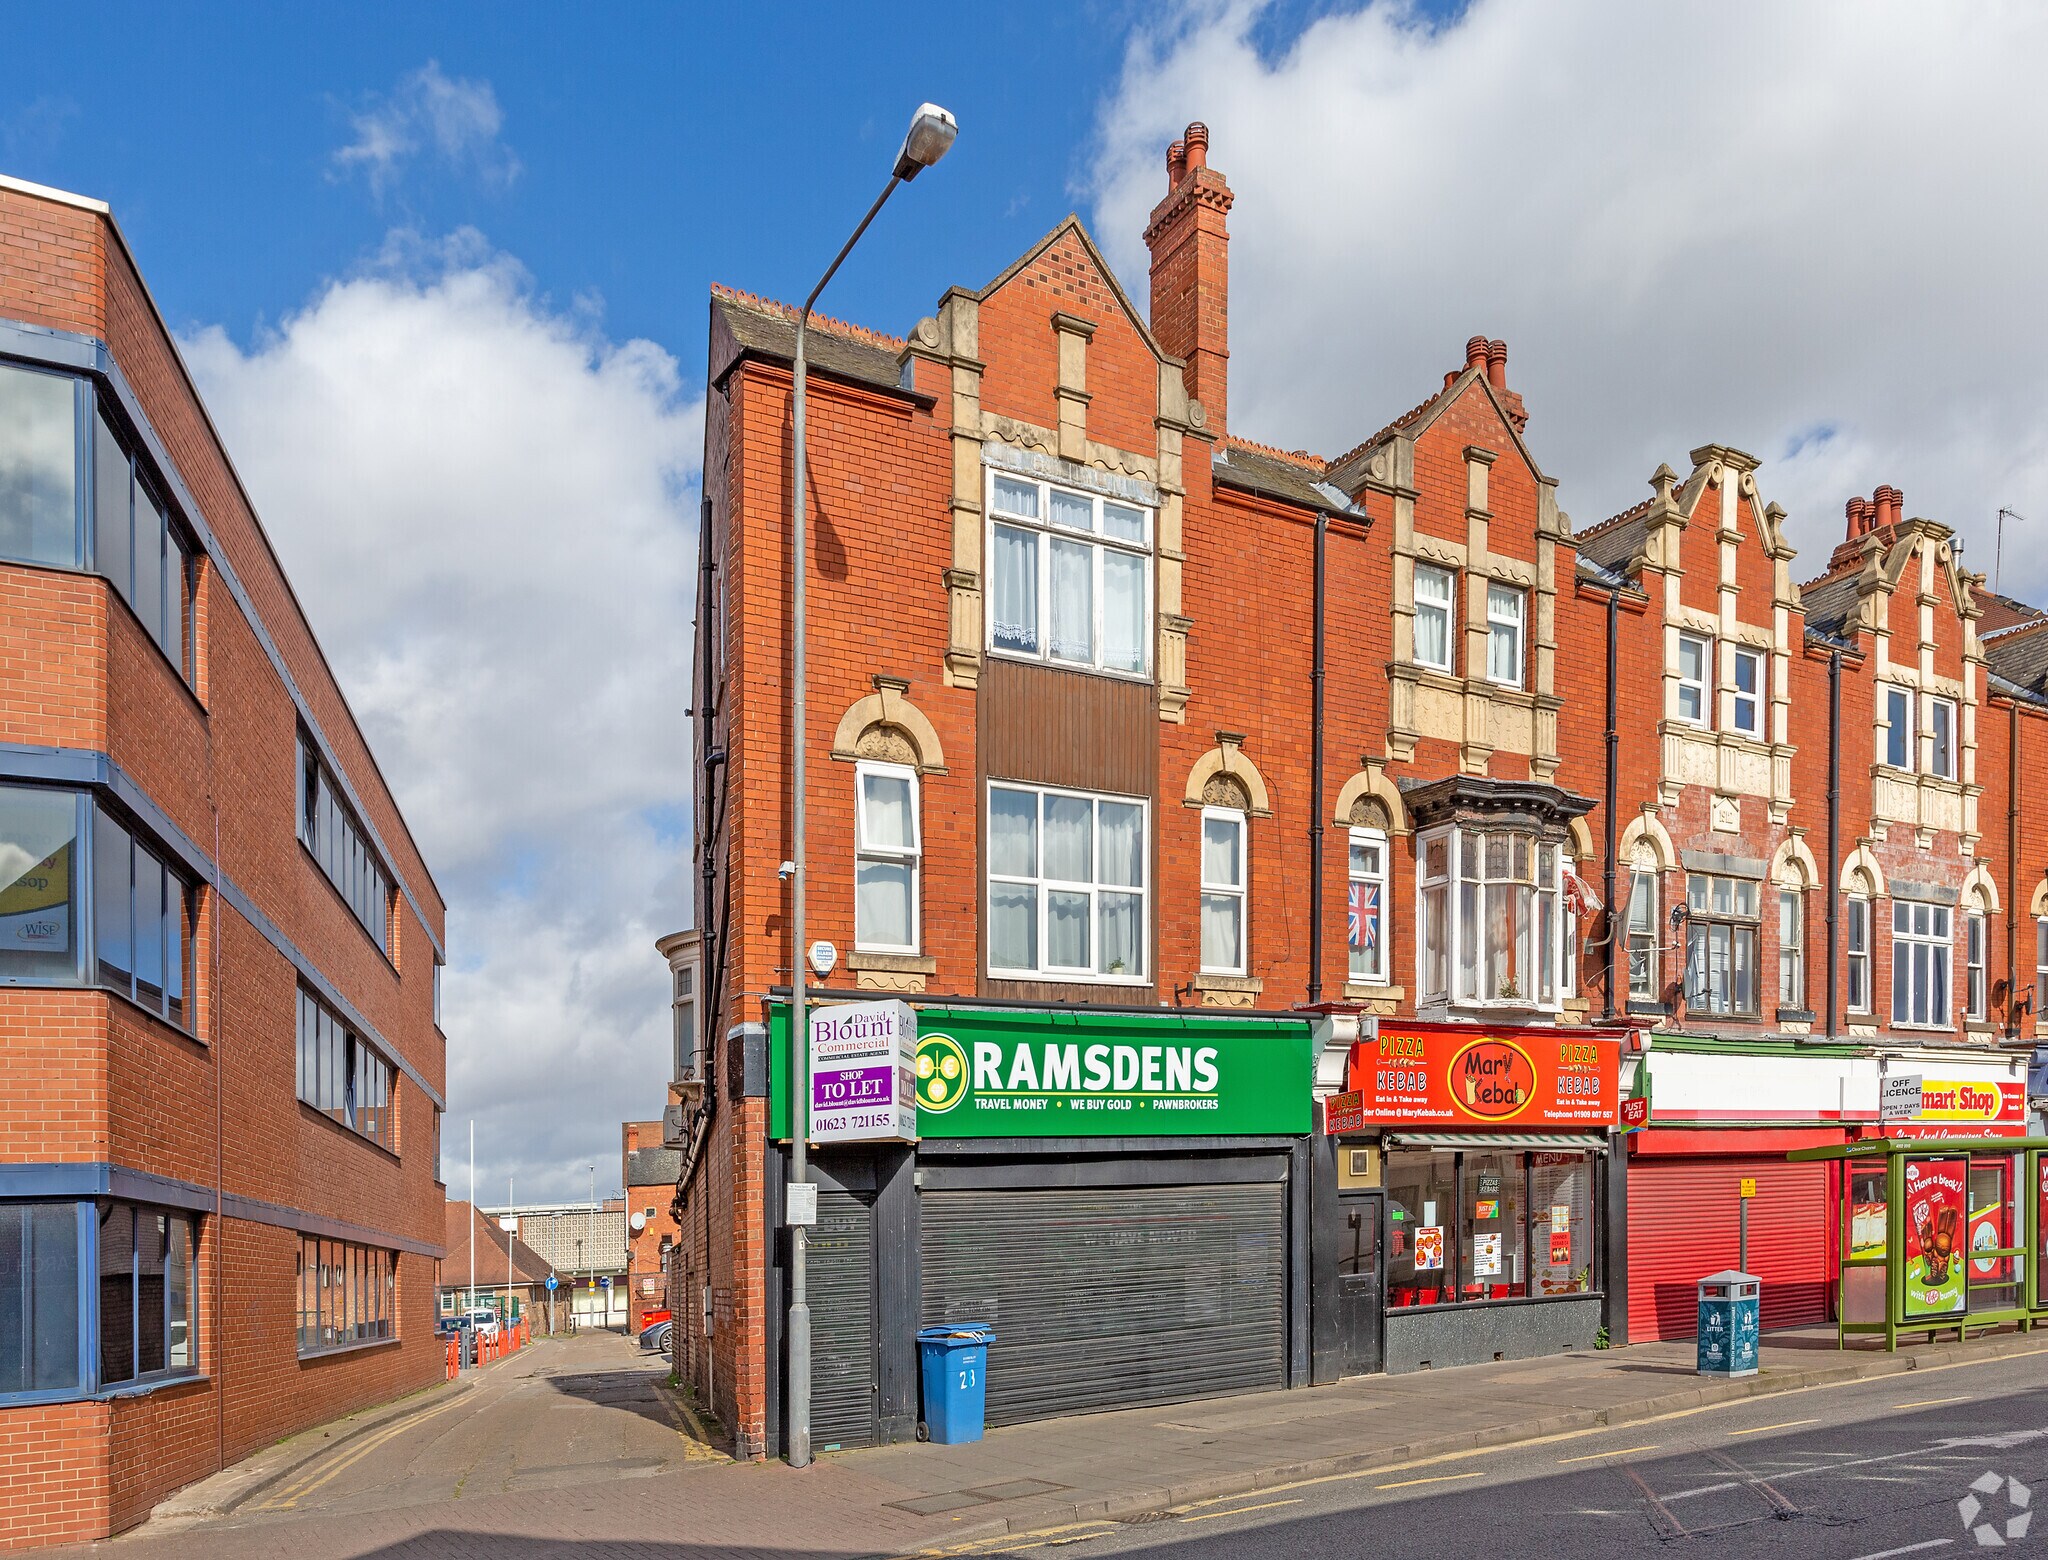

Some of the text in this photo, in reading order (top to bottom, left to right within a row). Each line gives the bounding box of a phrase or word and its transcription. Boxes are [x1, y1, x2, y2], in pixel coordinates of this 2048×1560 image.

[854, 1011, 886, 1024] David
[814, 1016, 893, 1042] Blount
[818, 1037, 889, 1054] Commercial
[1380, 1036, 1424, 1057] PIZZA
[1560, 1044, 1598, 1063] PIZZA
[974, 1041, 1219, 1092] RAMSDENS
[840, 1070, 864, 1080] SHOP
[1377, 1071, 1427, 1092] KEBAB
[822, 1079, 883, 1099] TO LET
[1558, 1076, 1600, 1095] KEBAB
[1892, 1079, 1910, 1088] OFF
[974, 1099, 1048, 1110] TRAVEL MONEY
[1070, 1100, 1132, 1110] WE BUY GOLD
[1153, 1100, 1218, 1110] PAWNBROKERS
[1330, 1094, 1359, 1110] PIZZA
[1624, 1101, 1644, 1112] JUST
[1922, 1086, 1994, 1116] mart Shop
[1375, 1108, 1396, 1116] Online
[1396, 1108, 1402, 1118] @
[1402, 1108, 1454, 1118] MaryKebab.co.uk
[1544, 1110, 1572, 1119] Telephone
[1628, 1111, 1644, 1120] EAT
[816, 1117, 846, 1132] 01623
[851, 1114, 890, 1128] 721155
[1330, 1114, 1362, 1132] KEBAB
[1919, 1128, 1939, 1139] Local
[1984, 1128, 2002, 1138] Store
[1536, 1152, 1563, 1164] MENU
[1914, 1177, 1932, 1192] Have
[1933, 1176, 1937, 1184] a
[1911, 1290, 1924, 1300] with
[1940, 1286, 1957, 1300] bunny
